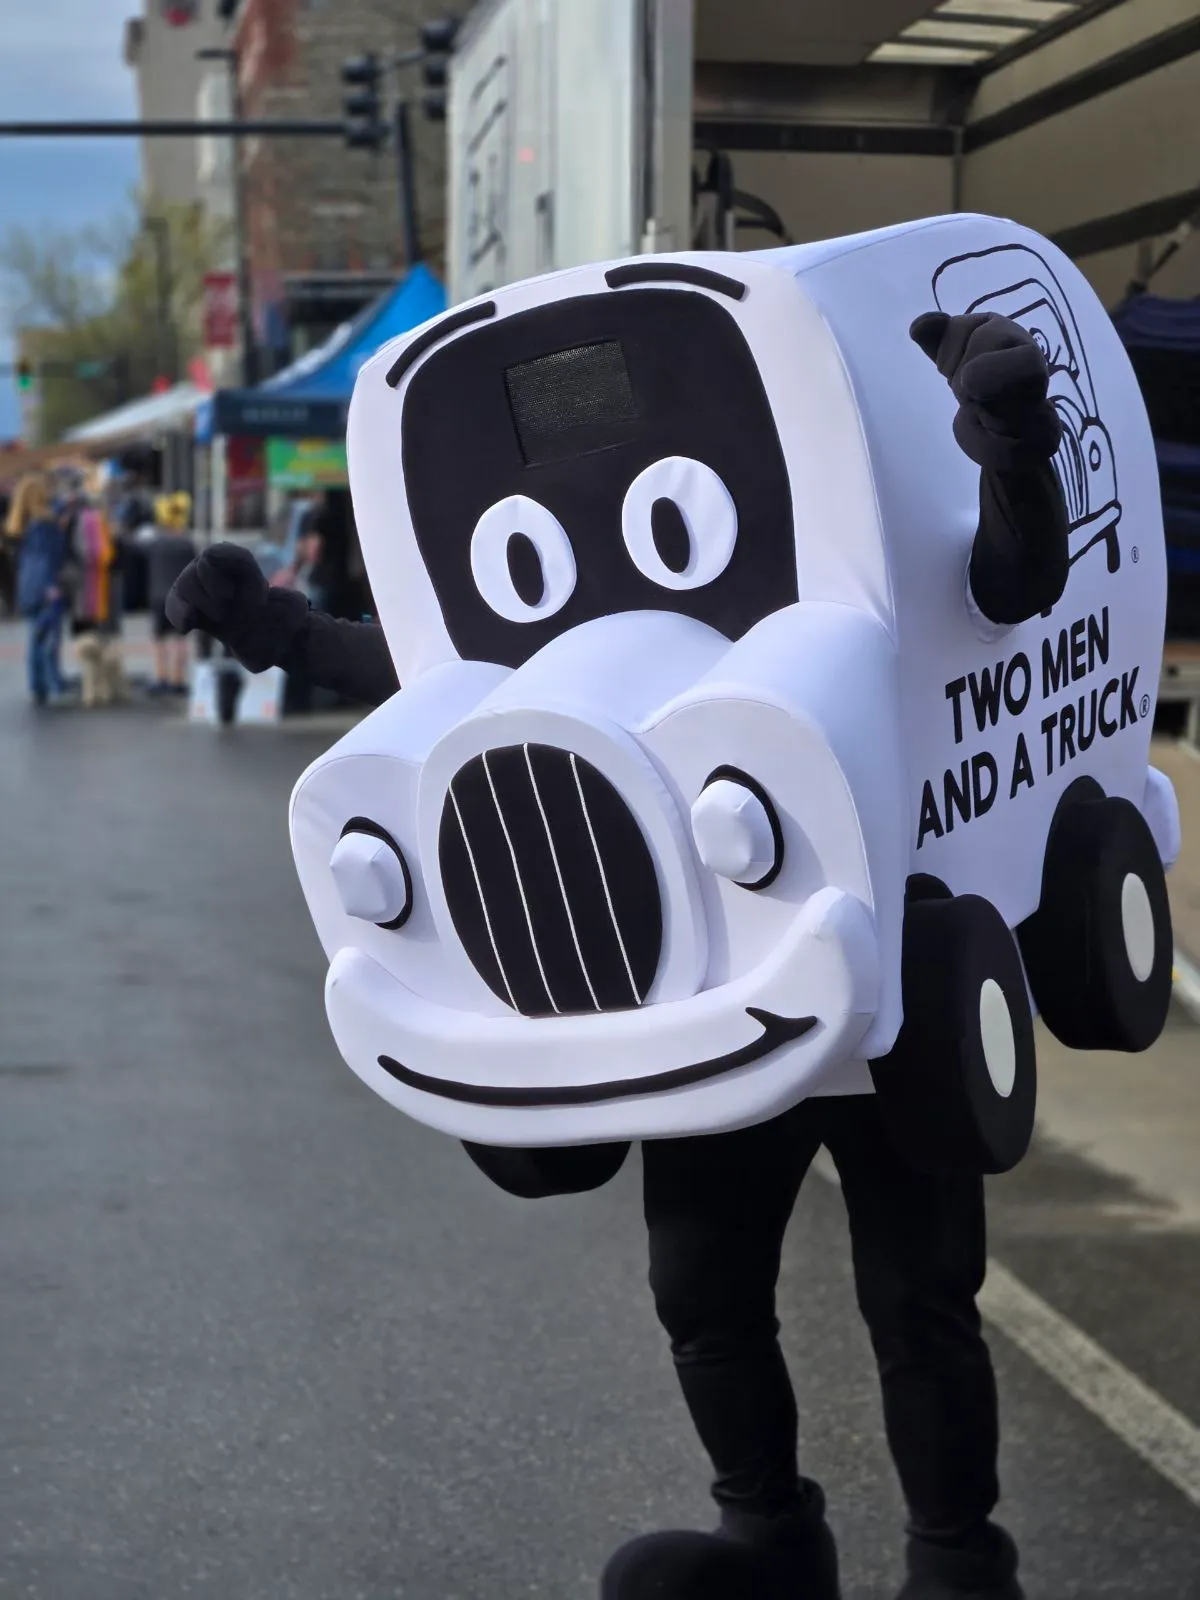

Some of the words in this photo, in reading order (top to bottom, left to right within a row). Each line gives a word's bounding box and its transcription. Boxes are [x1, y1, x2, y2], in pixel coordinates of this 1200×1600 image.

[945, 652, 1032, 745] TWO
[1042, 606, 1109, 699] MEN
[916, 751, 998, 850] AND
[1010, 732, 1035, 800] A
